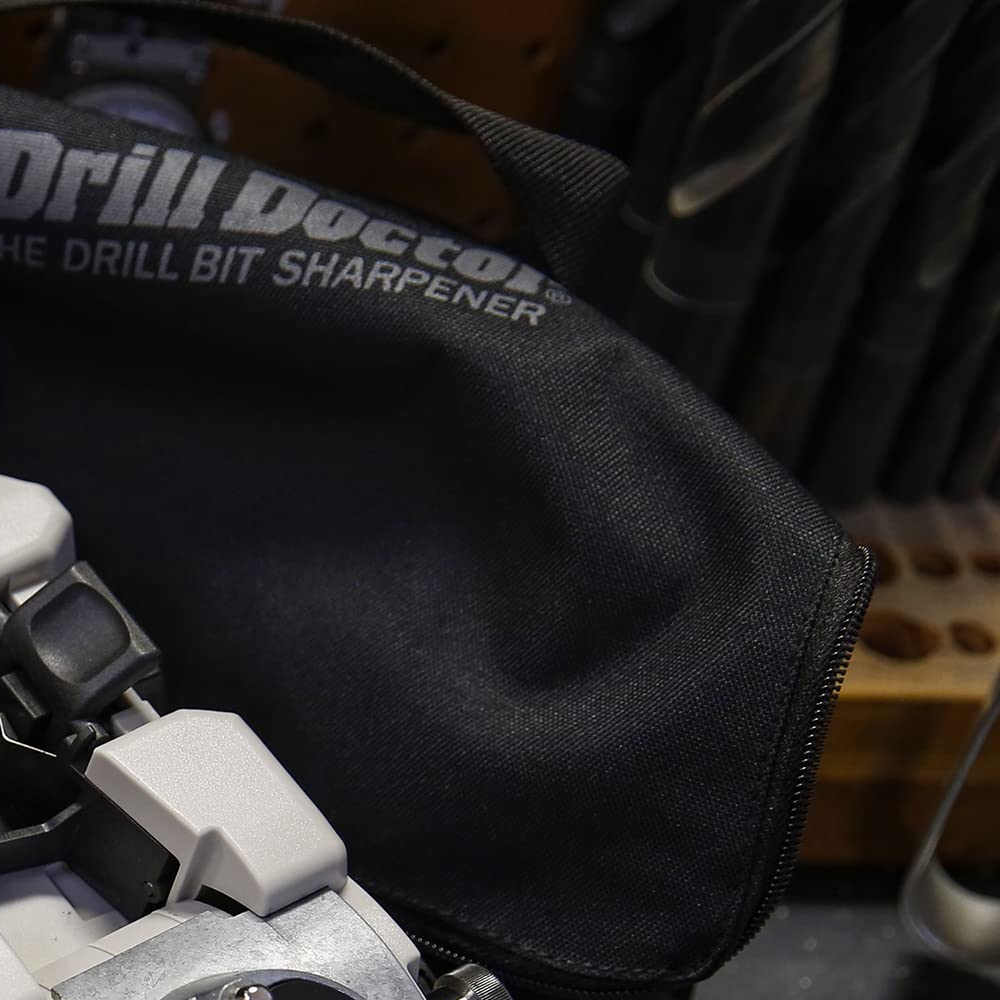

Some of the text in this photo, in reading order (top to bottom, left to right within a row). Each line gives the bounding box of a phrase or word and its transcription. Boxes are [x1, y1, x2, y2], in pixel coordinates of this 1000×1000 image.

[63, 236, 180, 282] DRILL
[188, 243, 266, 286] BIT
[271, 249, 548, 327] SHARPENER
